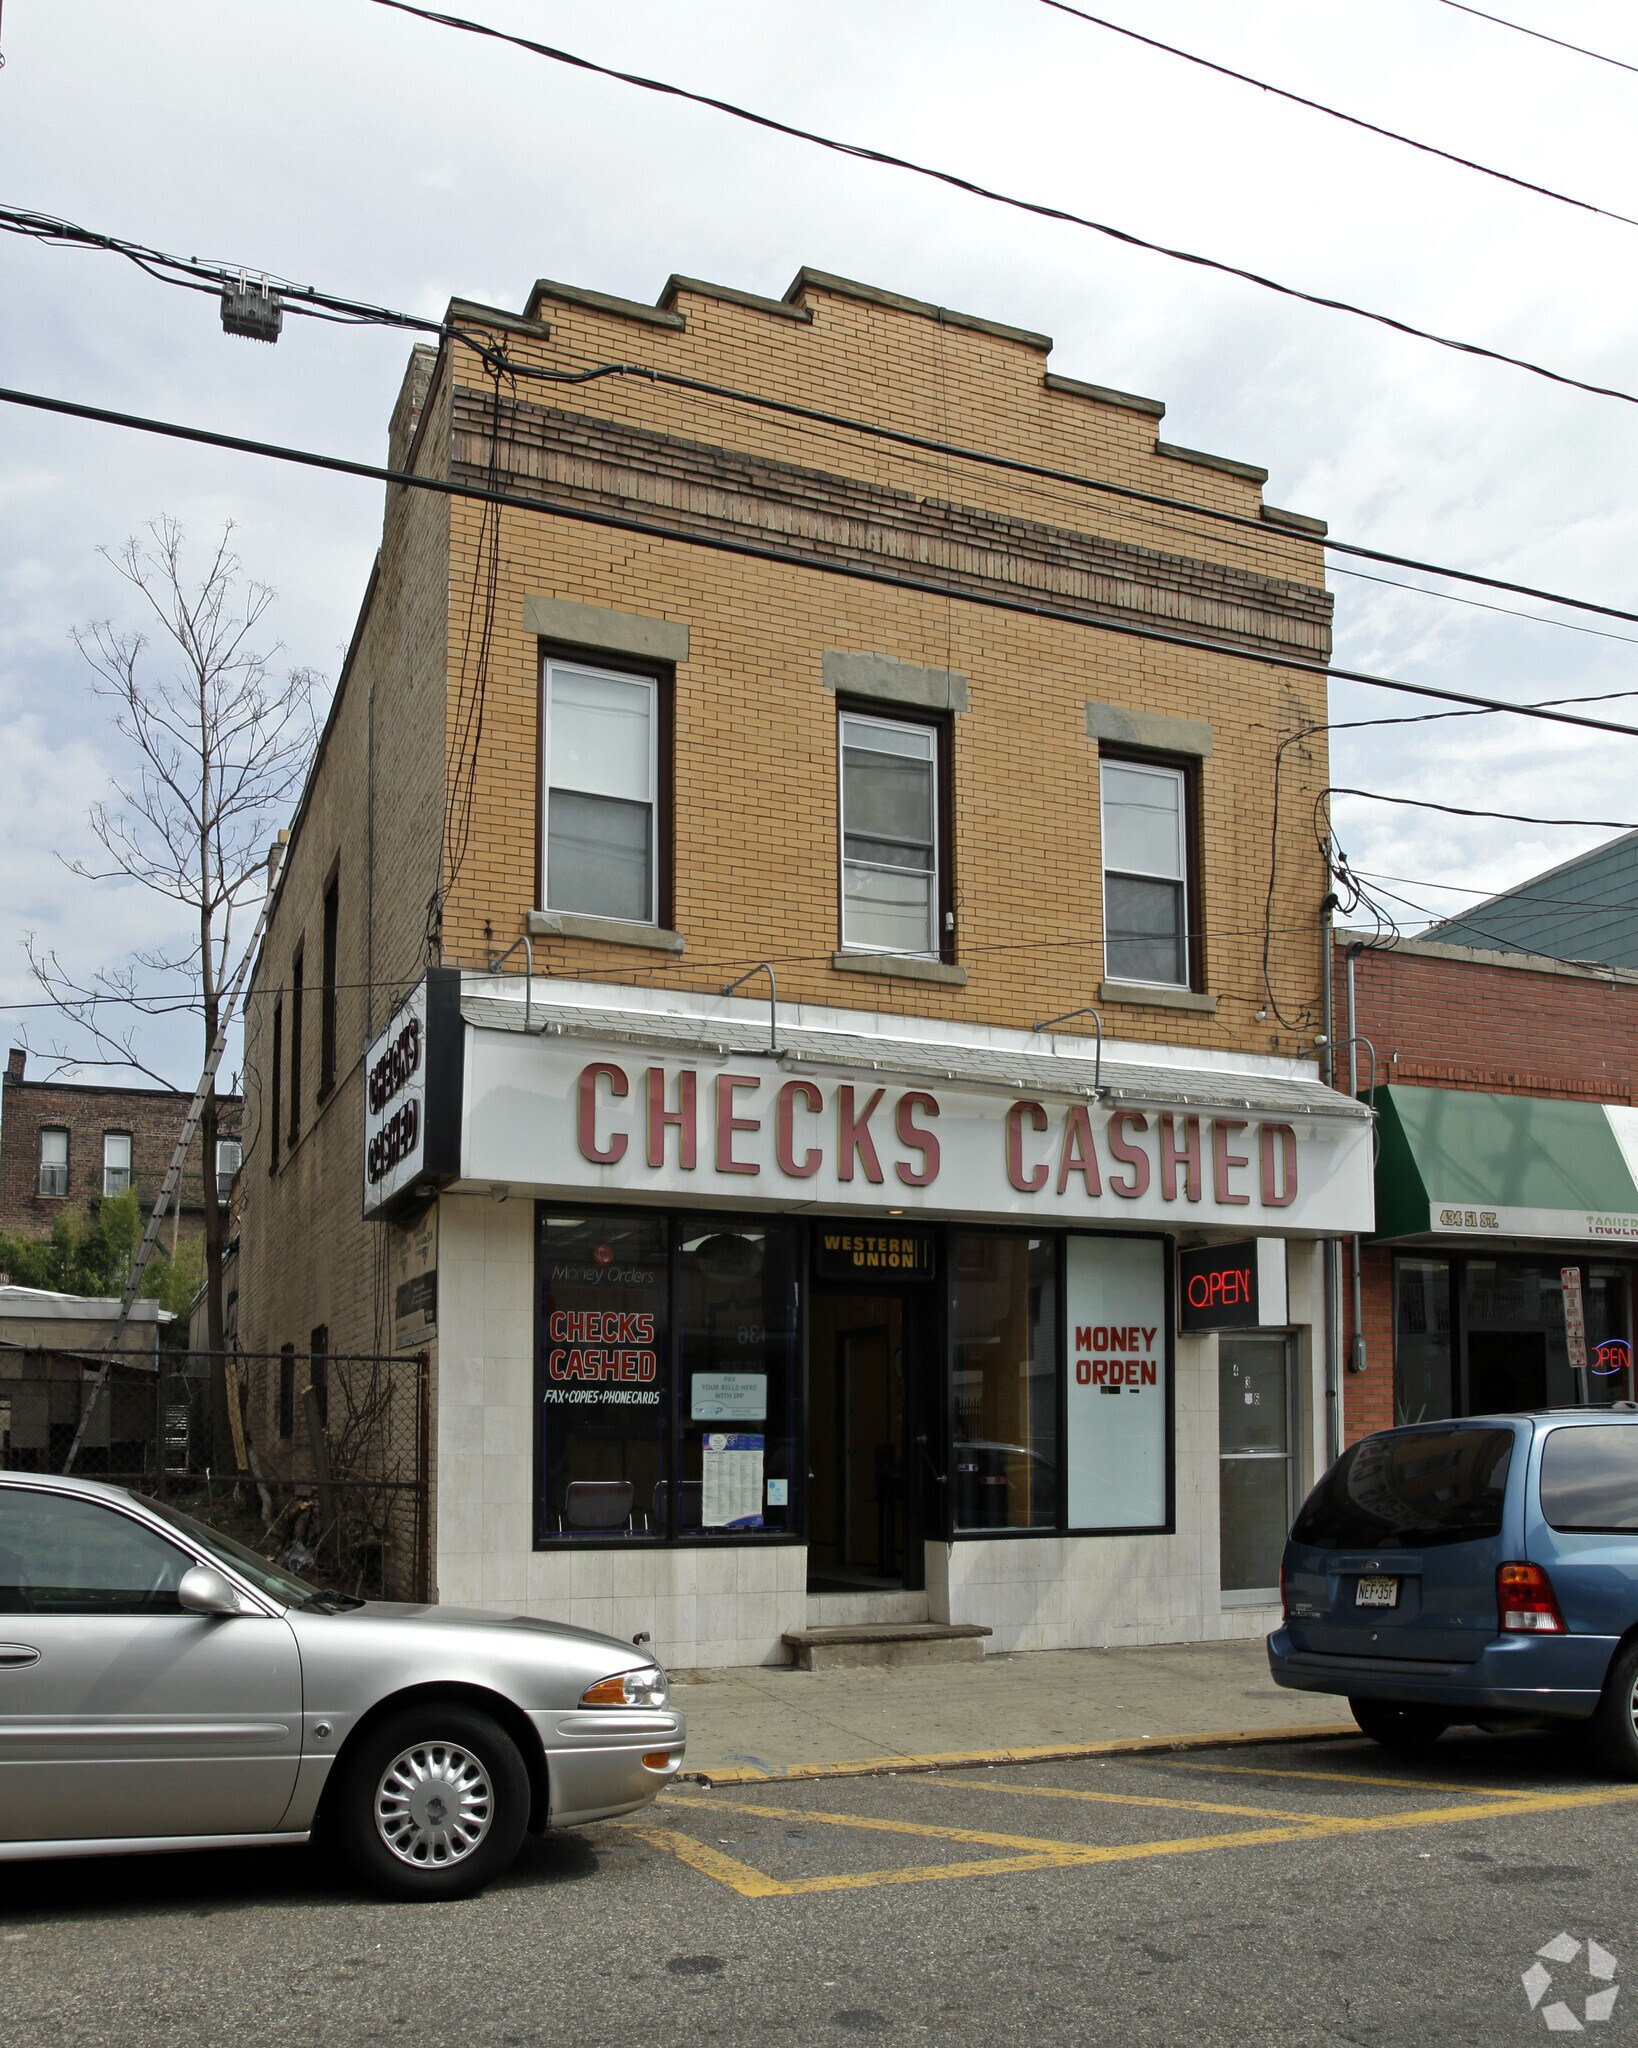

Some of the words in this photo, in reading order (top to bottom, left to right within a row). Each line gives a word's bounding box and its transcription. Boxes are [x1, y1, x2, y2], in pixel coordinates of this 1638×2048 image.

[577, 1061, 941, 1186] CHECKS
[1005, 1099, 1299, 1208] CASHED
[1440, 1210, 1462, 1227] 434
[1465, 1211, 1477, 1228] 51
[1480, 1212, 1499, 1228] ST.
[824, 1236, 913, 1253] WESTERN
[853, 1252, 913, 1268] UNION
[552, 1264, 604, 1285] Money
[607, 1266, 654, 1284] Orders
[1188, 1268, 1250, 1307] OPEN
[549, 1310, 655, 1344] CHECKS
[1075, 1326, 1158, 1352] MONEY
[549, 1349, 657, 1382] CASHED
[1076, 1359, 1157, 1386] ORDEN
[701, 1383, 720, 1392] YOUR
[720, 1384, 740, 1392] BILLS
[740, 1384, 758, 1392] HERE
[723, 1375, 737, 1384] PAY
[714, 1392, 732, 1400] WITH
